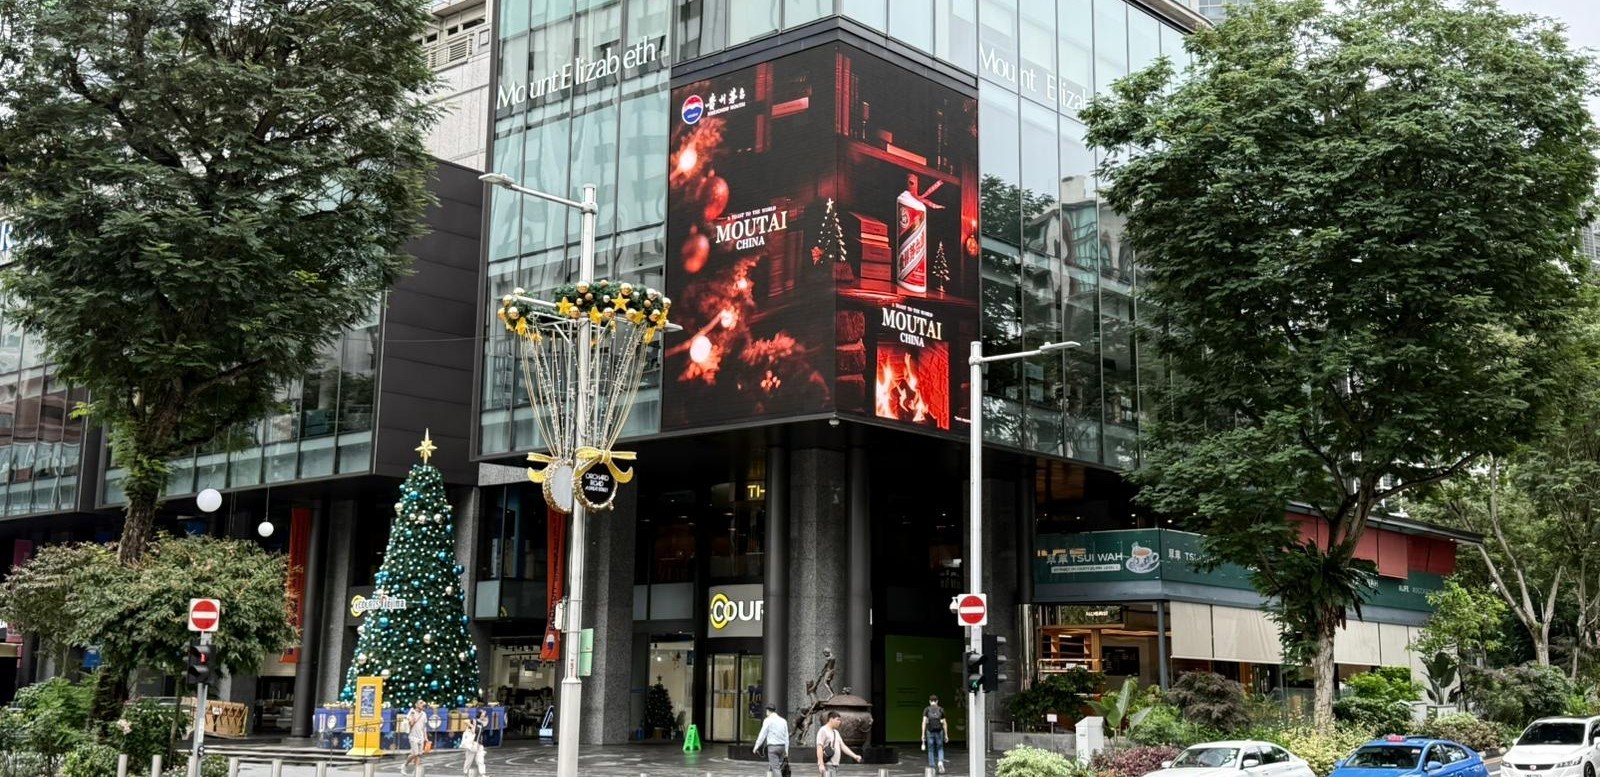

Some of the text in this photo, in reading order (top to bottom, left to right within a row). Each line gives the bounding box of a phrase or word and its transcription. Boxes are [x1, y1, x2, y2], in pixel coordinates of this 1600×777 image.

[496, 36, 656, 110] Mount Elizabeth
[979, 42, 1037, 92] Mount
[715, 211, 788, 244] MOUTAI
[735, 236, 766, 250] CHINA
[881, 307, 942, 340] MOUTAI
[899, 332, 925, 347] CHINA
[1072, 553, 1095, 563] TSUI
[1097, 552, 1123, 562] WAH
